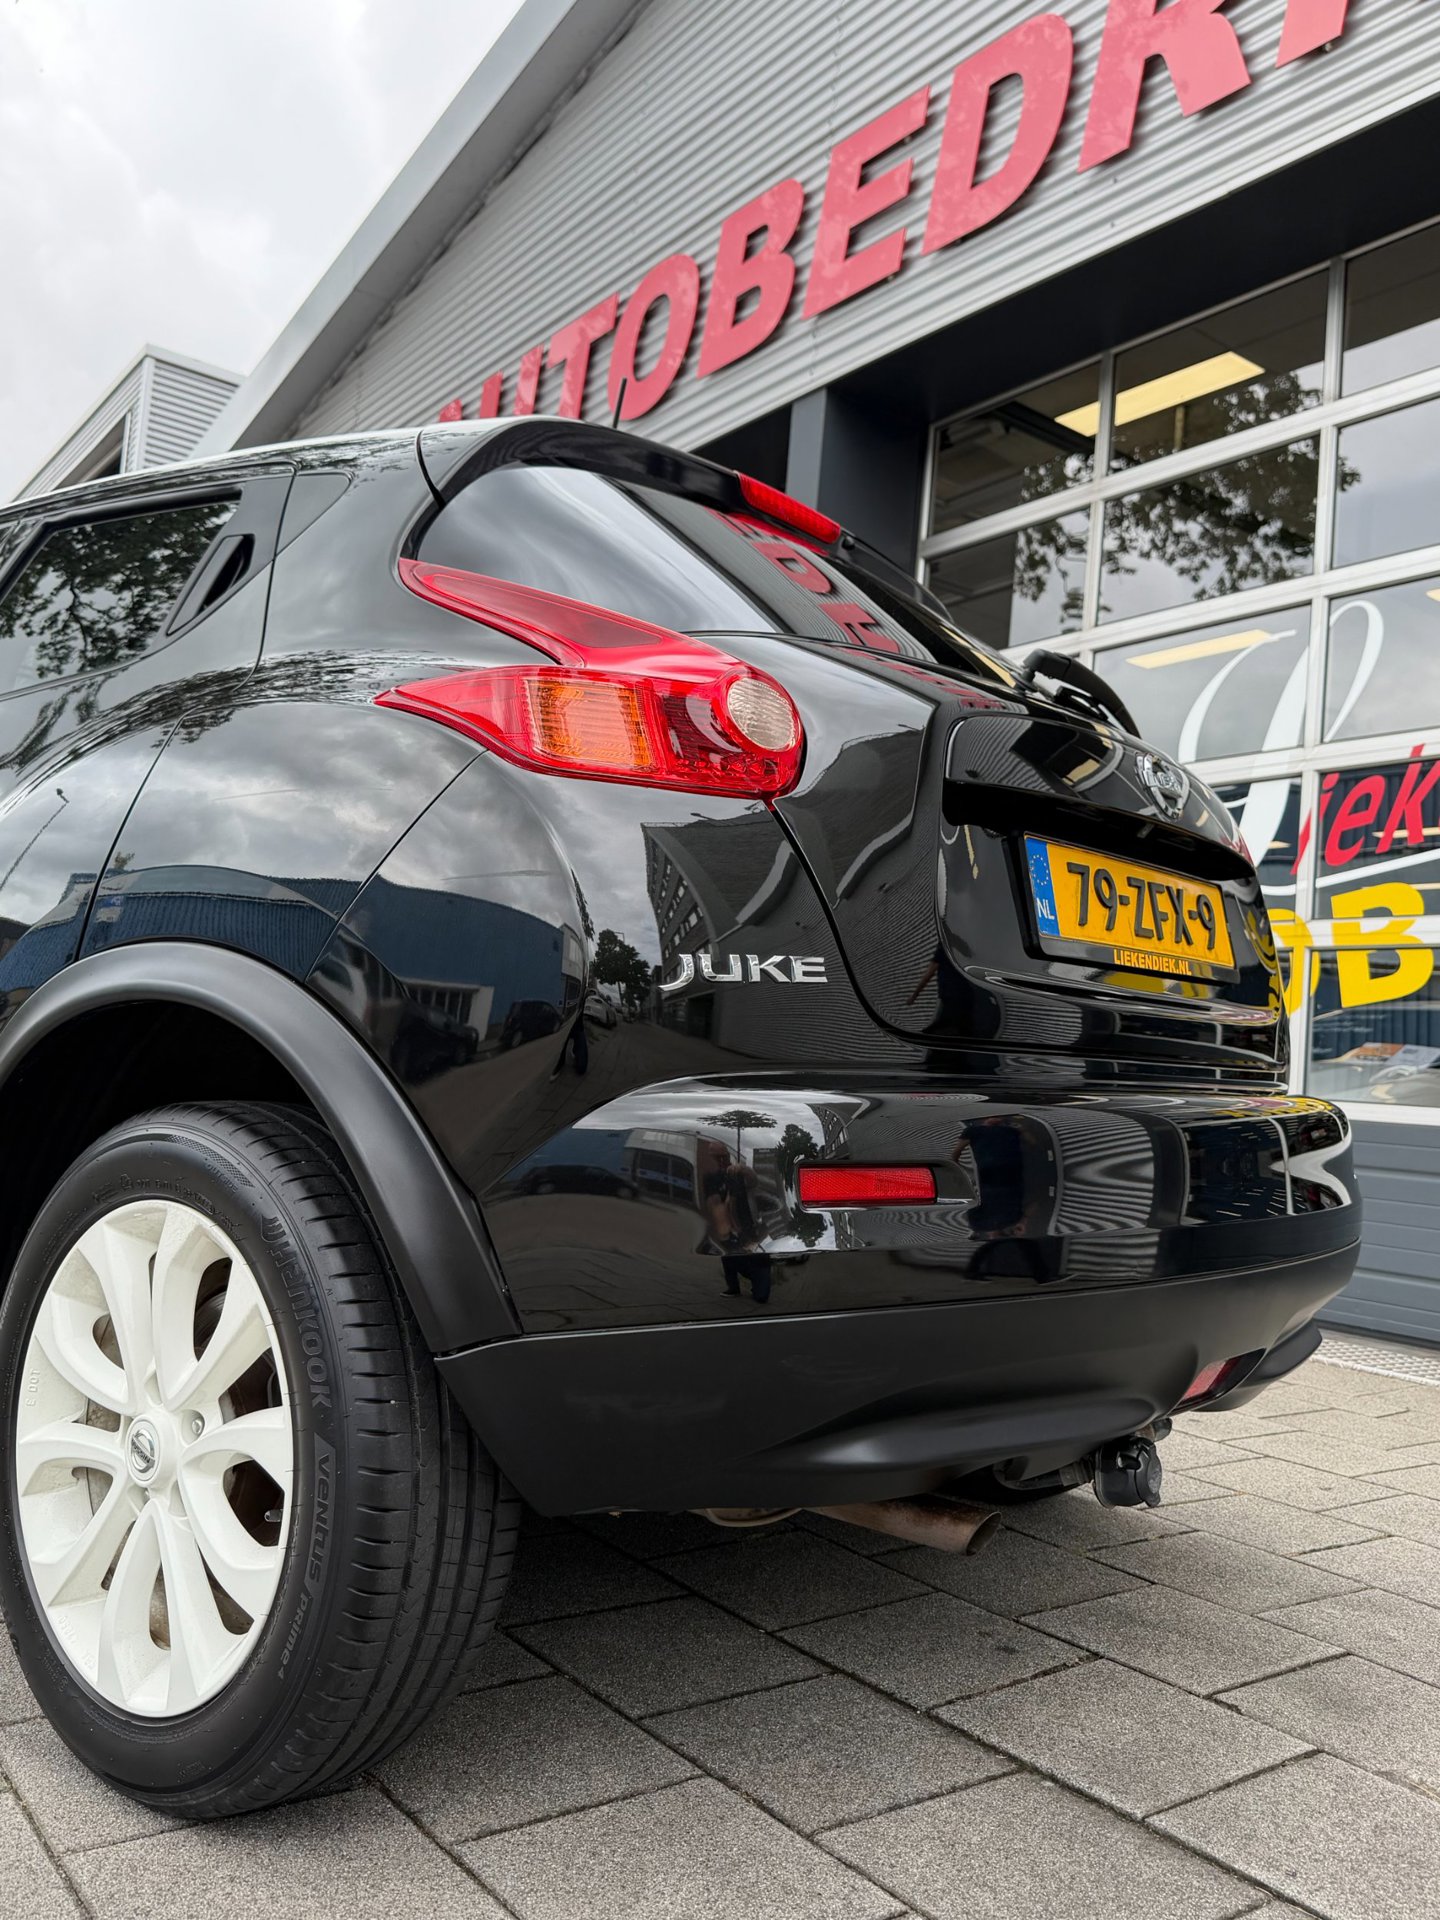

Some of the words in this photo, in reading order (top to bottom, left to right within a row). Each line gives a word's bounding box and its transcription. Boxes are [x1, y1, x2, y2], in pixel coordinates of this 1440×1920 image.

[1037, 897, 1056, 920] NL
[1066, 861, 1216, 951] 79-ZFX-9
[658, 953, 829, 992] JUKE
[1113, 948, 1193, 976] LIEKENDIEK.NL
